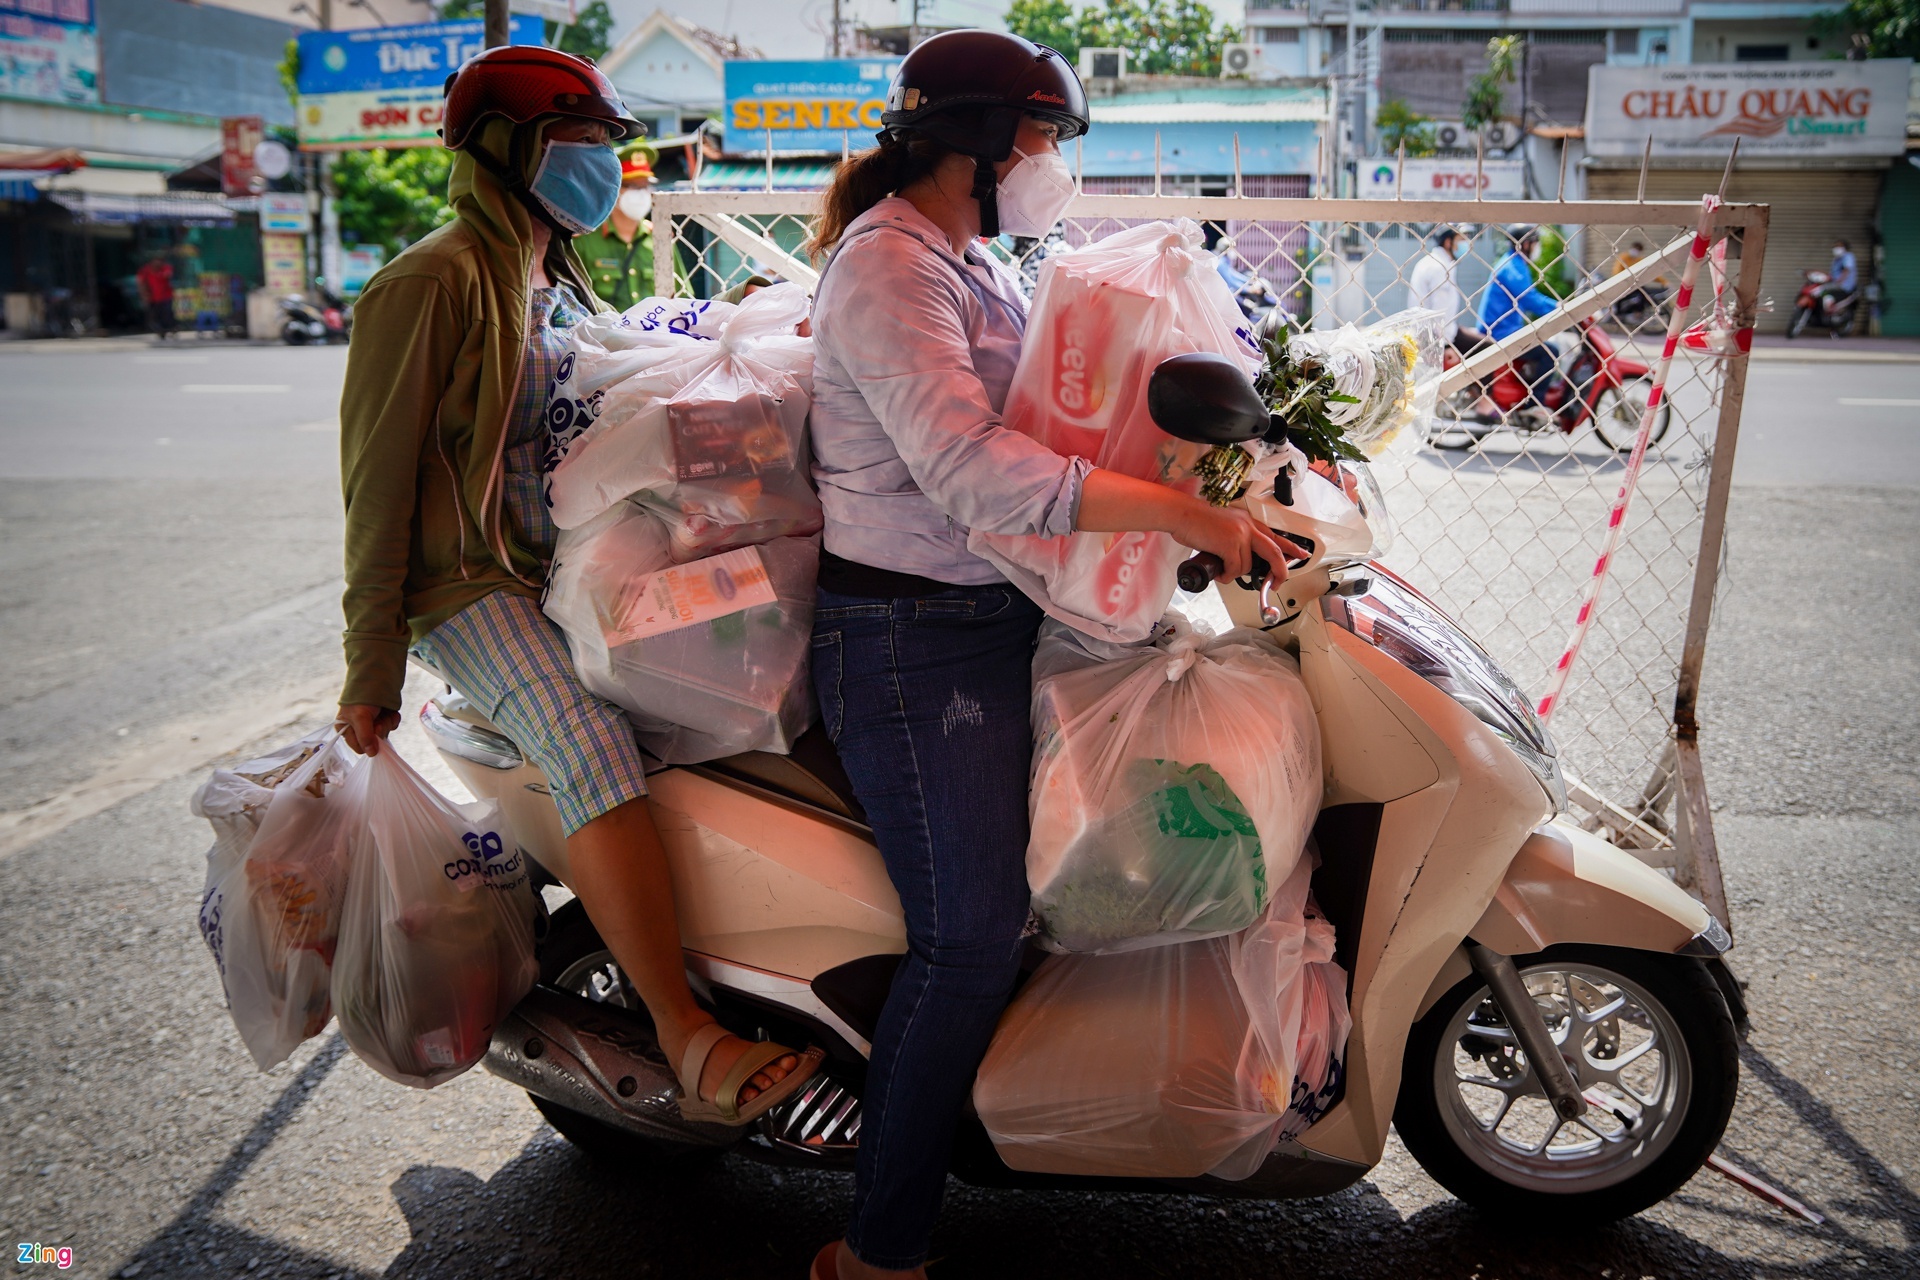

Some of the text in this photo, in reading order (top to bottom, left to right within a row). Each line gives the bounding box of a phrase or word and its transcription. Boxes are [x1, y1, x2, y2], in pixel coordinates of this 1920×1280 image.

[733, 99, 886, 130] SENKO
[1622, 84, 1872, 119] CHÂU QUANG
[1431, 172, 1490, 190] BTICO
